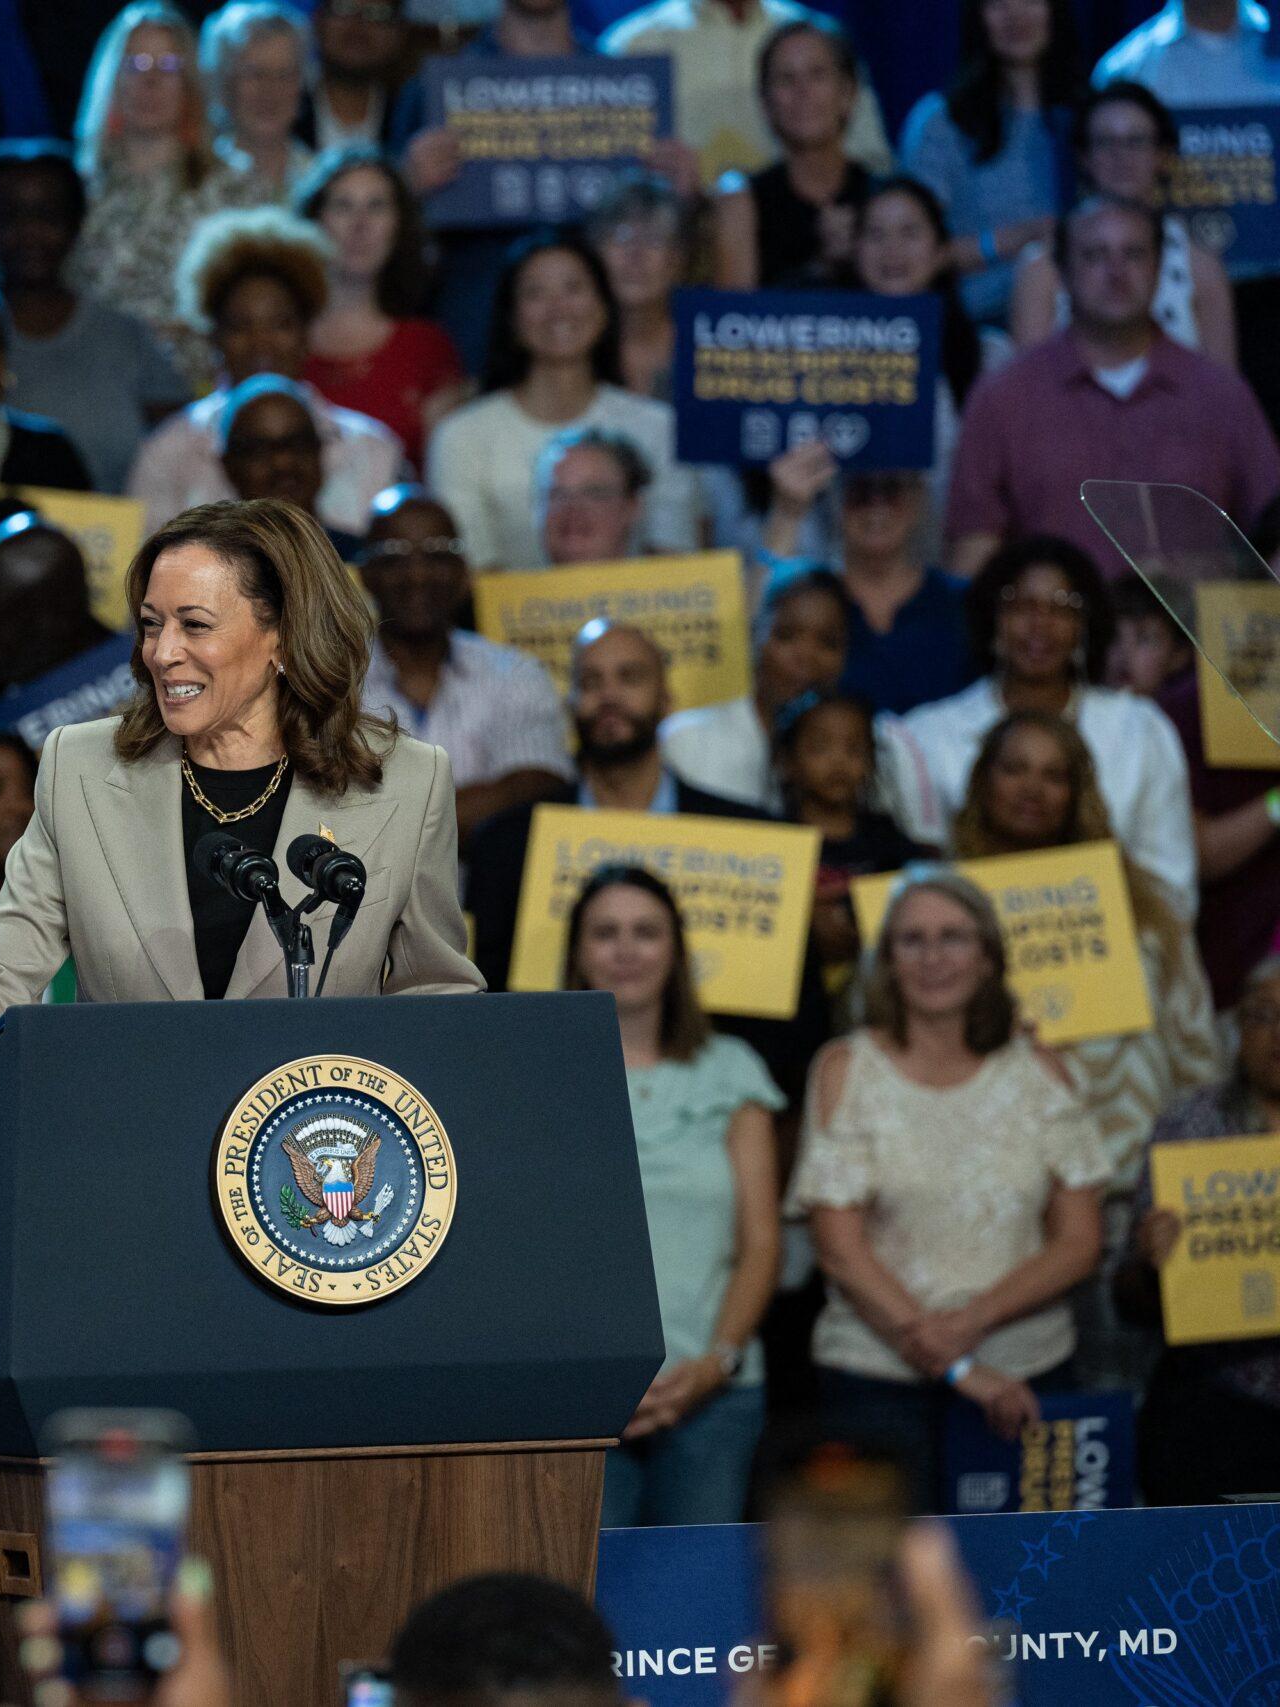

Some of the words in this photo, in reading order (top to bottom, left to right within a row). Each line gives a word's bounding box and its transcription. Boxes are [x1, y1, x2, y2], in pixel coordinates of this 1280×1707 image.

[694, 312, 919, 353] LOWERING
[330, 1066, 352, 1082] OF
[357, 1070, 388, 1095] THE
[224, 1064, 322, 1177] PRESIDENT
[393, 1090, 449, 1191] UNITED
[229, 1186, 248, 1222] THE
[241, 1225, 260, 1246] OF
[365, 1213, 442, 1291] STATES
[261, 1244, 323, 1293] SEAL
[1120, 1628, 1177, 1656] MD
[610, 1646, 717, 1678] RINCE
